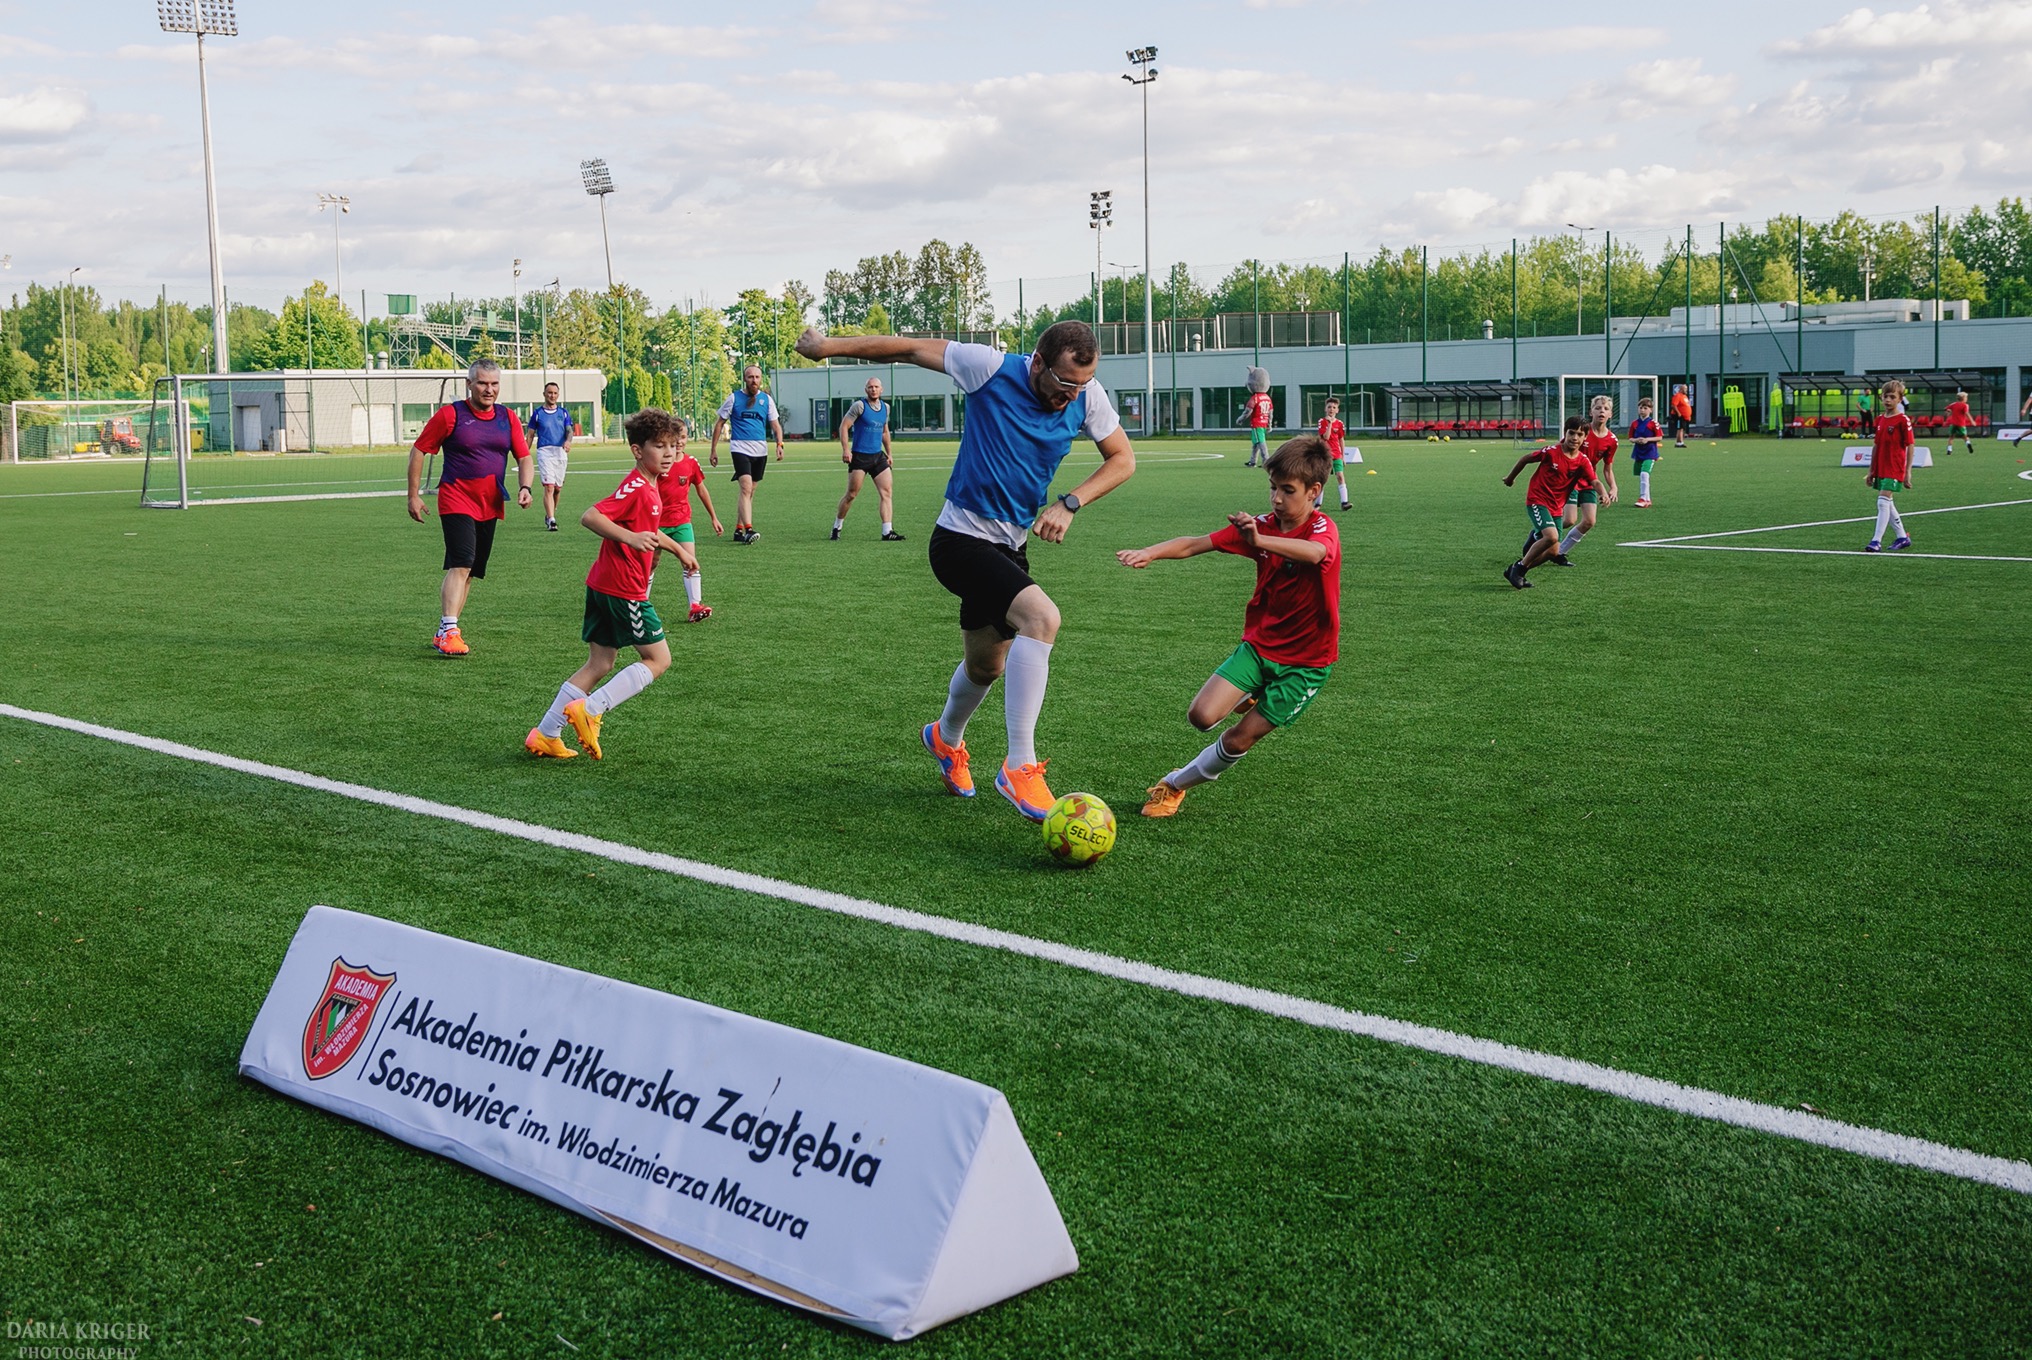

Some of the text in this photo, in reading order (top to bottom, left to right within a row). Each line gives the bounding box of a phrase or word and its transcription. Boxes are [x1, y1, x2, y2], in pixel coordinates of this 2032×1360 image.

[1069, 825, 1107, 846] SELECT
[333, 973, 379, 1000] AKADEMIA
[324, 1003, 369, 1055] WŁODZIMIERZA
[332, 1026, 358, 1057] MAZURA
[391, 997, 882, 1188] Akademia Piłkarska Zagłębia
[368, 1049, 809, 1240] Sosnowiec im. Włodzimierza Mazura
